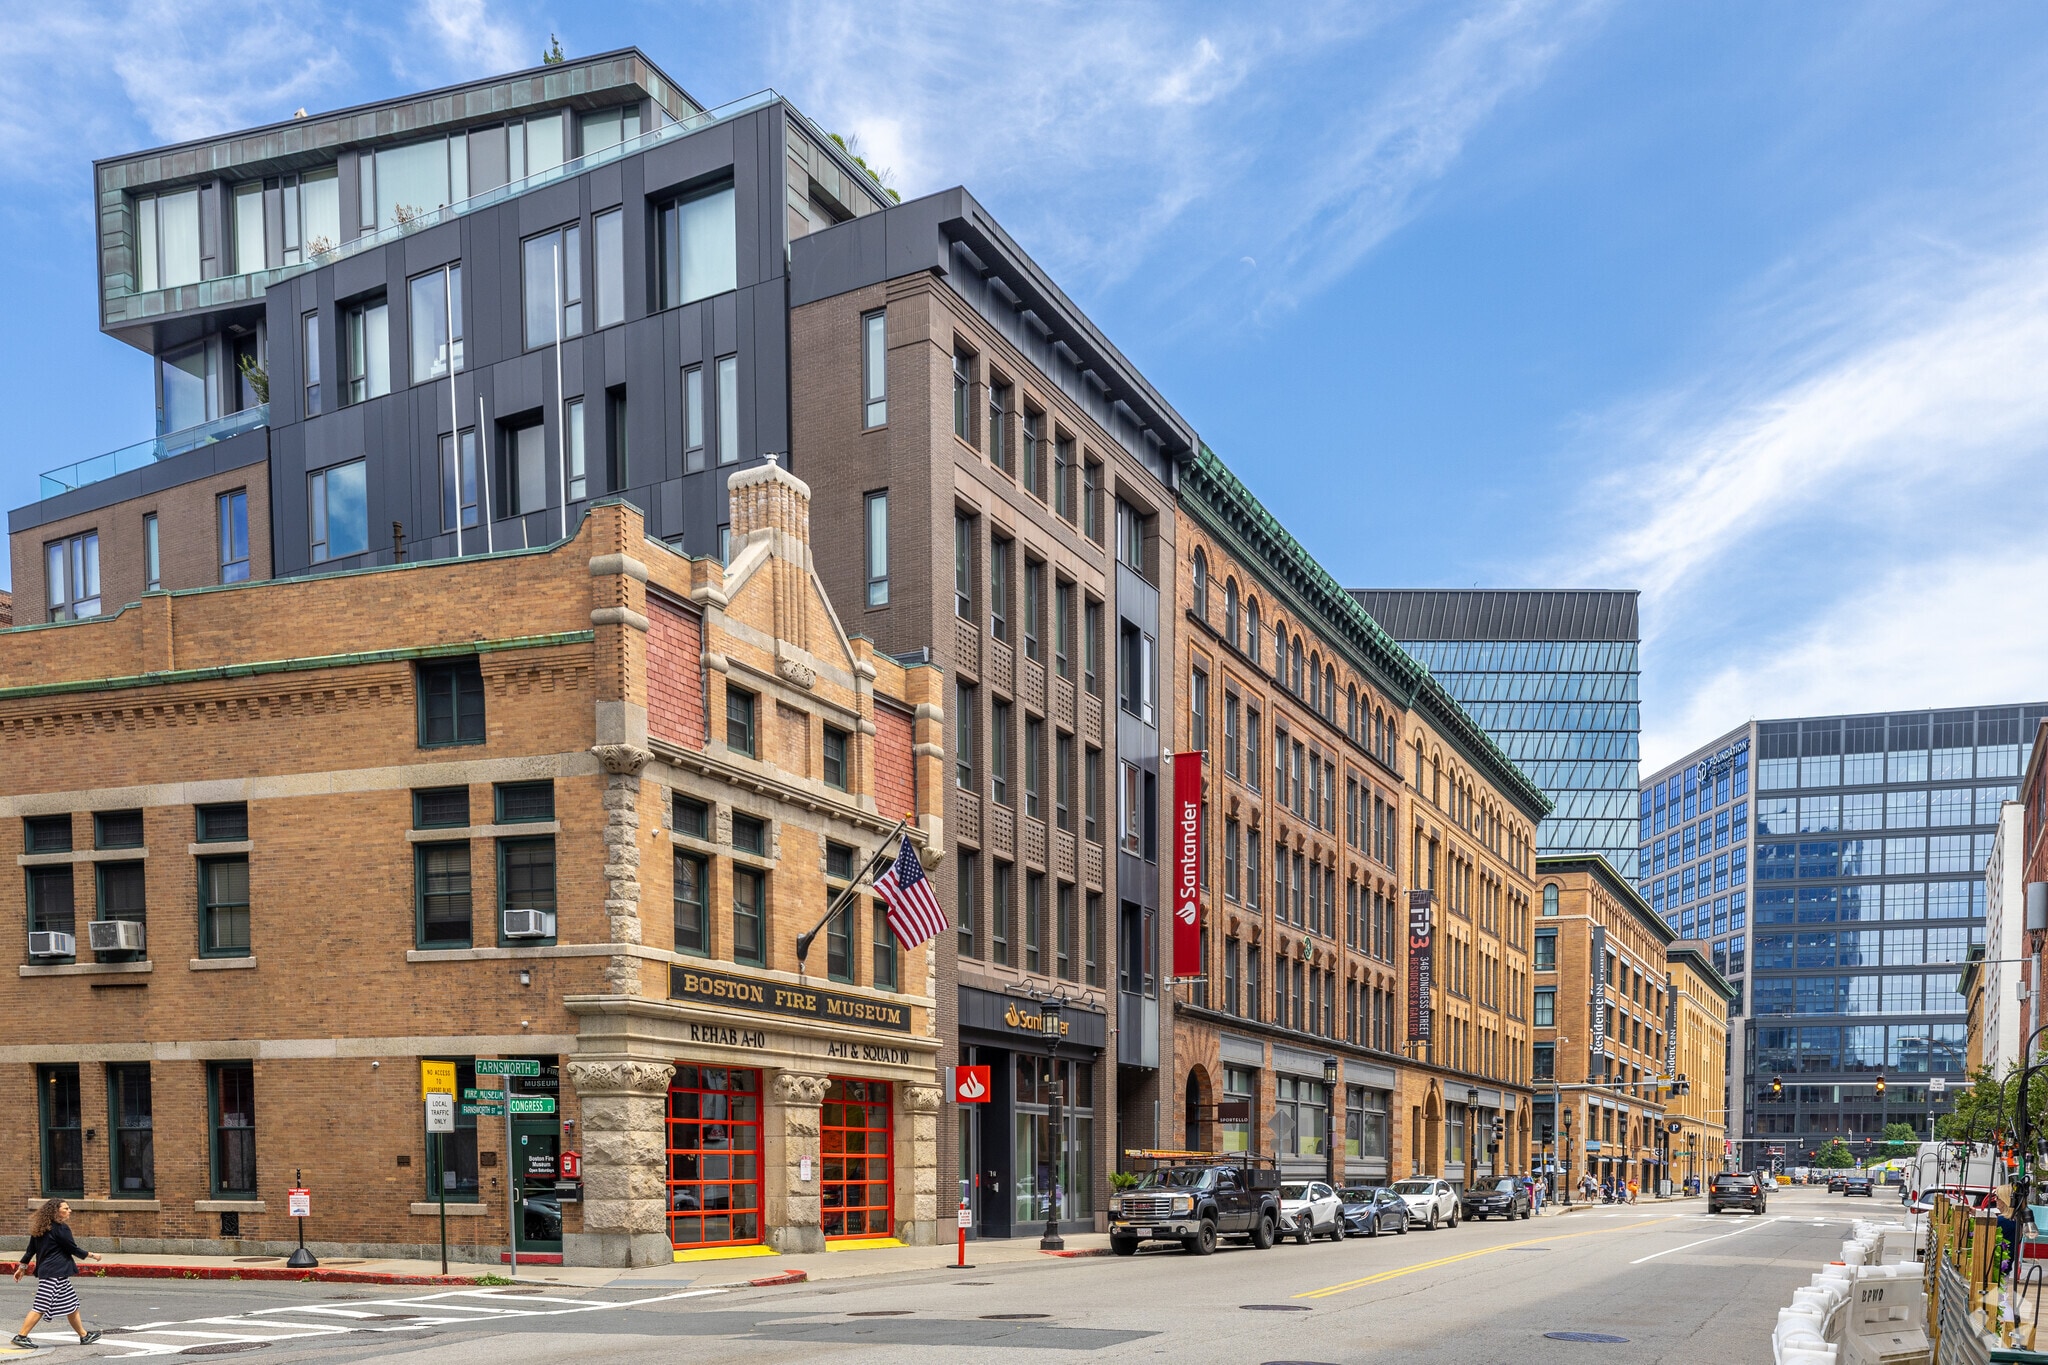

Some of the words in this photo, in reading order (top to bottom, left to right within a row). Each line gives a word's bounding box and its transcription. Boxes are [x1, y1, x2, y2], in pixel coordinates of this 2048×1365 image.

[1710, 741, 1748, 766] FOUNDATION
[1180, 801, 1197, 898] Santander
[1420, 956, 1429, 970] 346
[1409, 957, 1419, 999] RESIDENCES
[1596, 983, 1604, 997] INN
[684, 974, 764, 1003] BOSTON
[775, 989, 817, 1011] FIRE
[827, 998, 901, 1024] MUSEUM
[1420, 972, 1429, 1009] CONGRESS
[1020, 1010, 1070, 1035] Santer
[1409, 1007, 1418, 1036] GALLERY
[1419, 1010, 1429, 1035] STREET
[1593, 998, 1604, 1055] Residence
[690, 1024, 737, 1045] REHAB
[740, 1029, 765, 1048] A-10
[828, 1041, 848, 1058] A-11
[850, 1043, 859, 1059] &
[863, 1044, 899, 1063] SQUAD
[900, 1049, 909, 1065] 10
[477, 1062, 531, 1074] FARNSWORTH
[465, 1089, 478, 1097] FIRE
[480, 1090, 504, 1099] MUSEUM
[463, 1105, 491, 1114] FARNSWORTH
[511, 1101, 543, 1112] CONGRESS
[1861, 1288, 1884, 1303] BPWD
